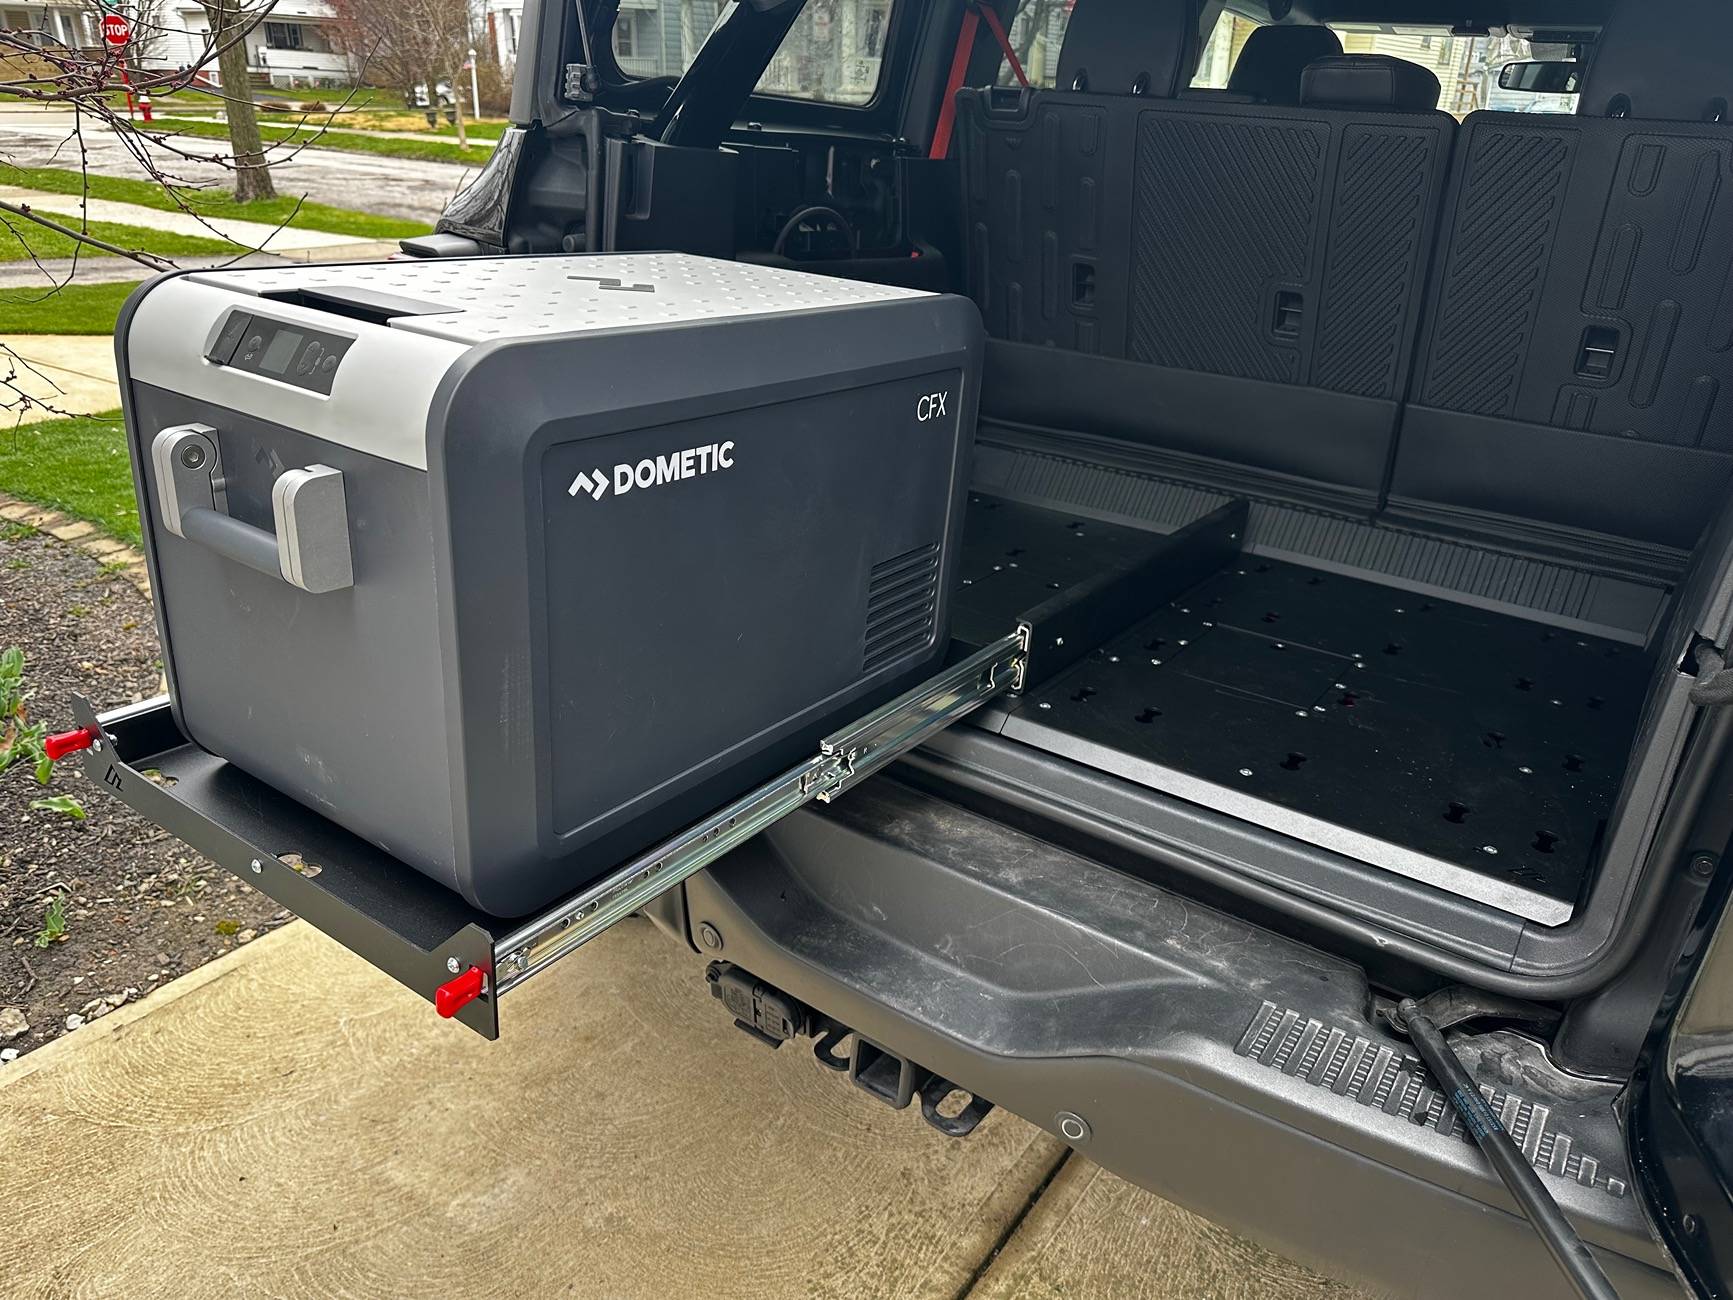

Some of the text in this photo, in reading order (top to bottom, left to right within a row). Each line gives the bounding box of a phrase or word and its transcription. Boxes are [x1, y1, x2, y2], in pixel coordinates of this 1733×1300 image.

[102, 24, 128, 36] STOP
[917, 392, 948, 422] CFX
[614, 441, 735, 495] DOMETIC
